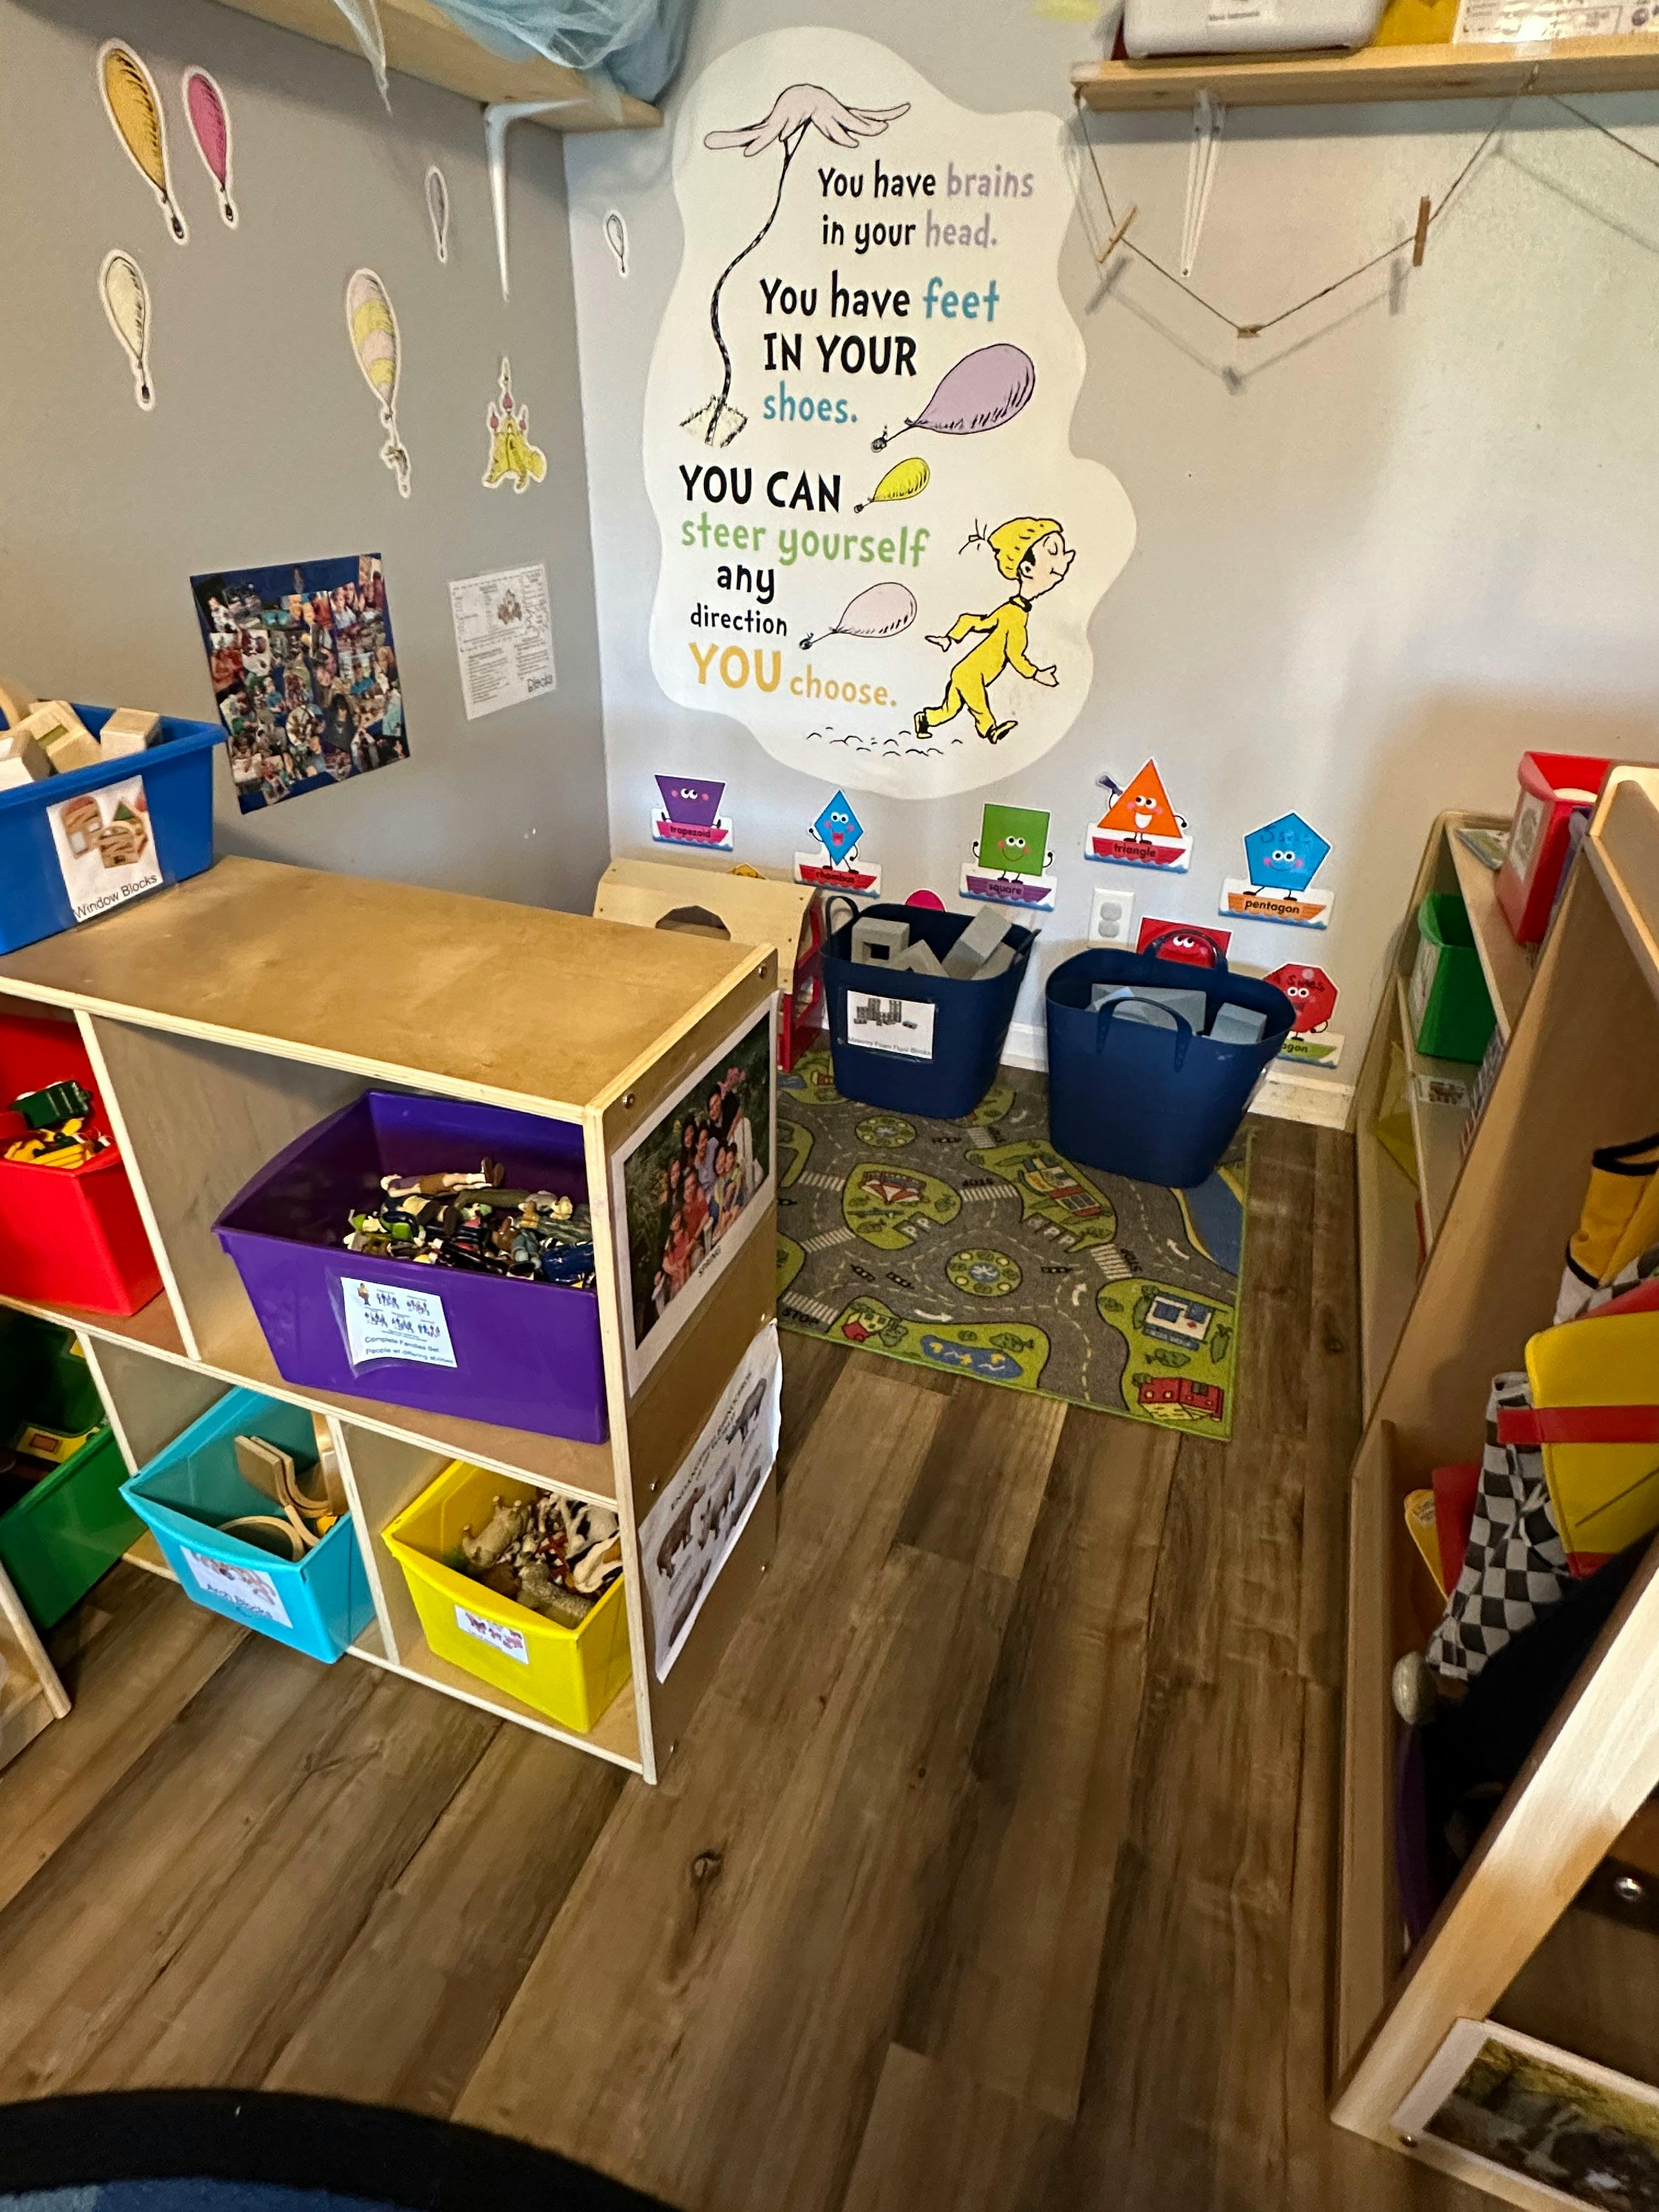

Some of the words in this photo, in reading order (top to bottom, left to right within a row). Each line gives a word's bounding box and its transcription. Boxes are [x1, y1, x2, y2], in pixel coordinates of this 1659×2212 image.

[818, 167, 863, 198] You
[874, 159, 936, 198] have
[947, 162, 1034, 198] brains
[823, 215, 844, 245] in
[855, 222, 916, 255] your
[926, 210, 997, 249] head.
[759, 277, 817, 317] You
[831, 270, 910, 319] have
[923, 276, 1000, 321] feet
[764, 332, 802, 371] IN
[815, 335, 917, 376] YOUR
[763, 381, 857, 424] shoes.
[679, 465, 752, 504] YOU
[767, 470, 840, 512] CAN
[682, 512, 766, 551] steer
[778, 526, 930, 567] yourself
[717, 565, 774, 604] any
[691, 603, 787, 636] direction
[689, 643, 781, 693] YOU
[790, 665, 896, 706] choose.
[670, 826, 710, 837] trapezoid
[1114, 843, 1156, 857] triangle
[74, 892, 119, 918] Window
[122, 874, 157, 896] Blocks
[816, 870, 854, 883] rhombus
[989, 883, 1022, 894] square
[1245, 900, 1300, 913] pentagon
[782, 1307, 819, 1324] STOP
[364, 1336, 398, 1345] Complete
